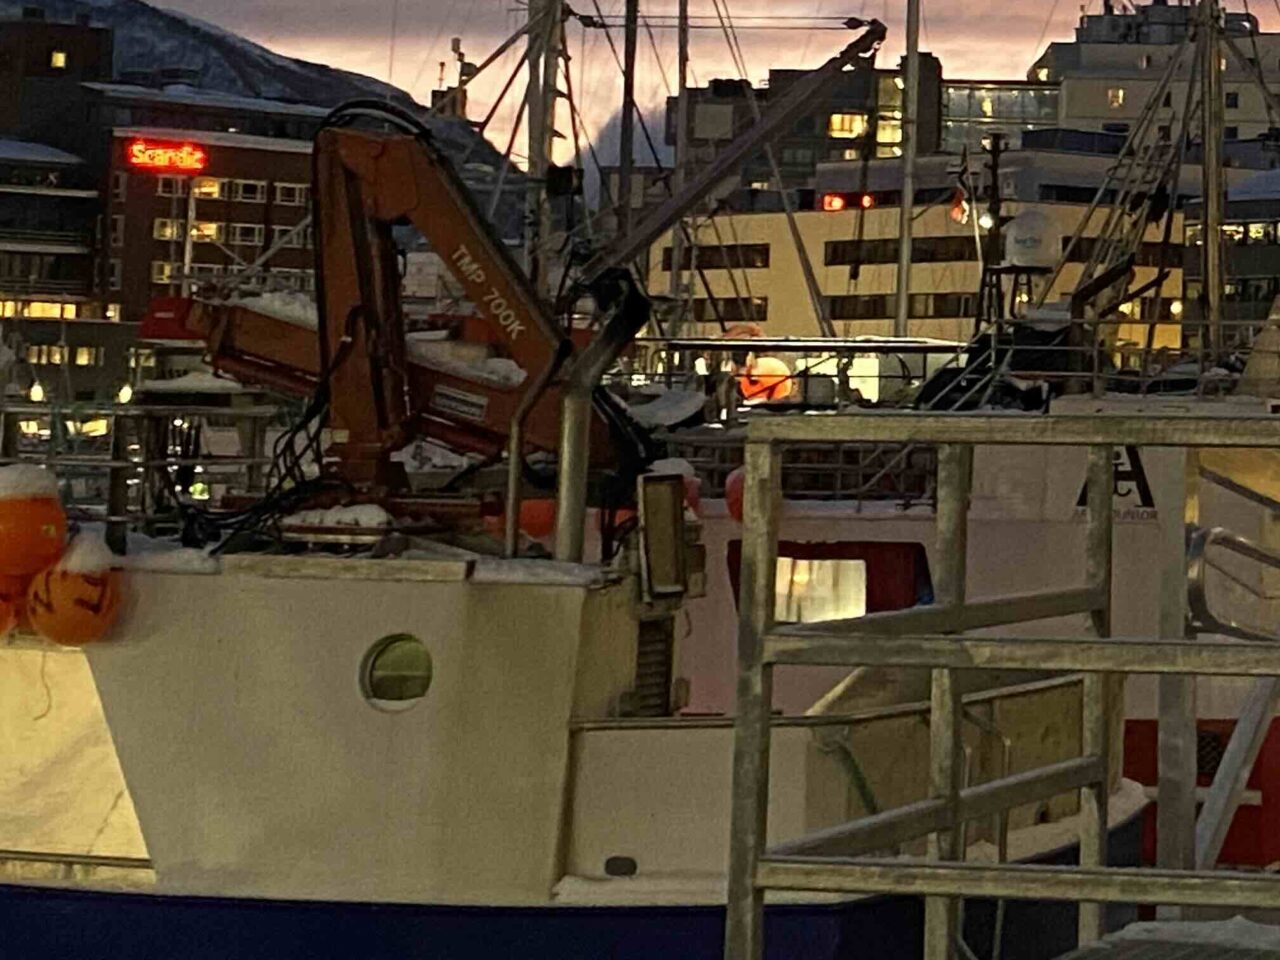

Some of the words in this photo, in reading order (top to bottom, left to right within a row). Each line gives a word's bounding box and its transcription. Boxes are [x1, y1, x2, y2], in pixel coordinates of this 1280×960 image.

[131, 143, 204, 170] Scandic
[452, 244, 487, 284] TMP
[482, 288, 527, 341] 700K
